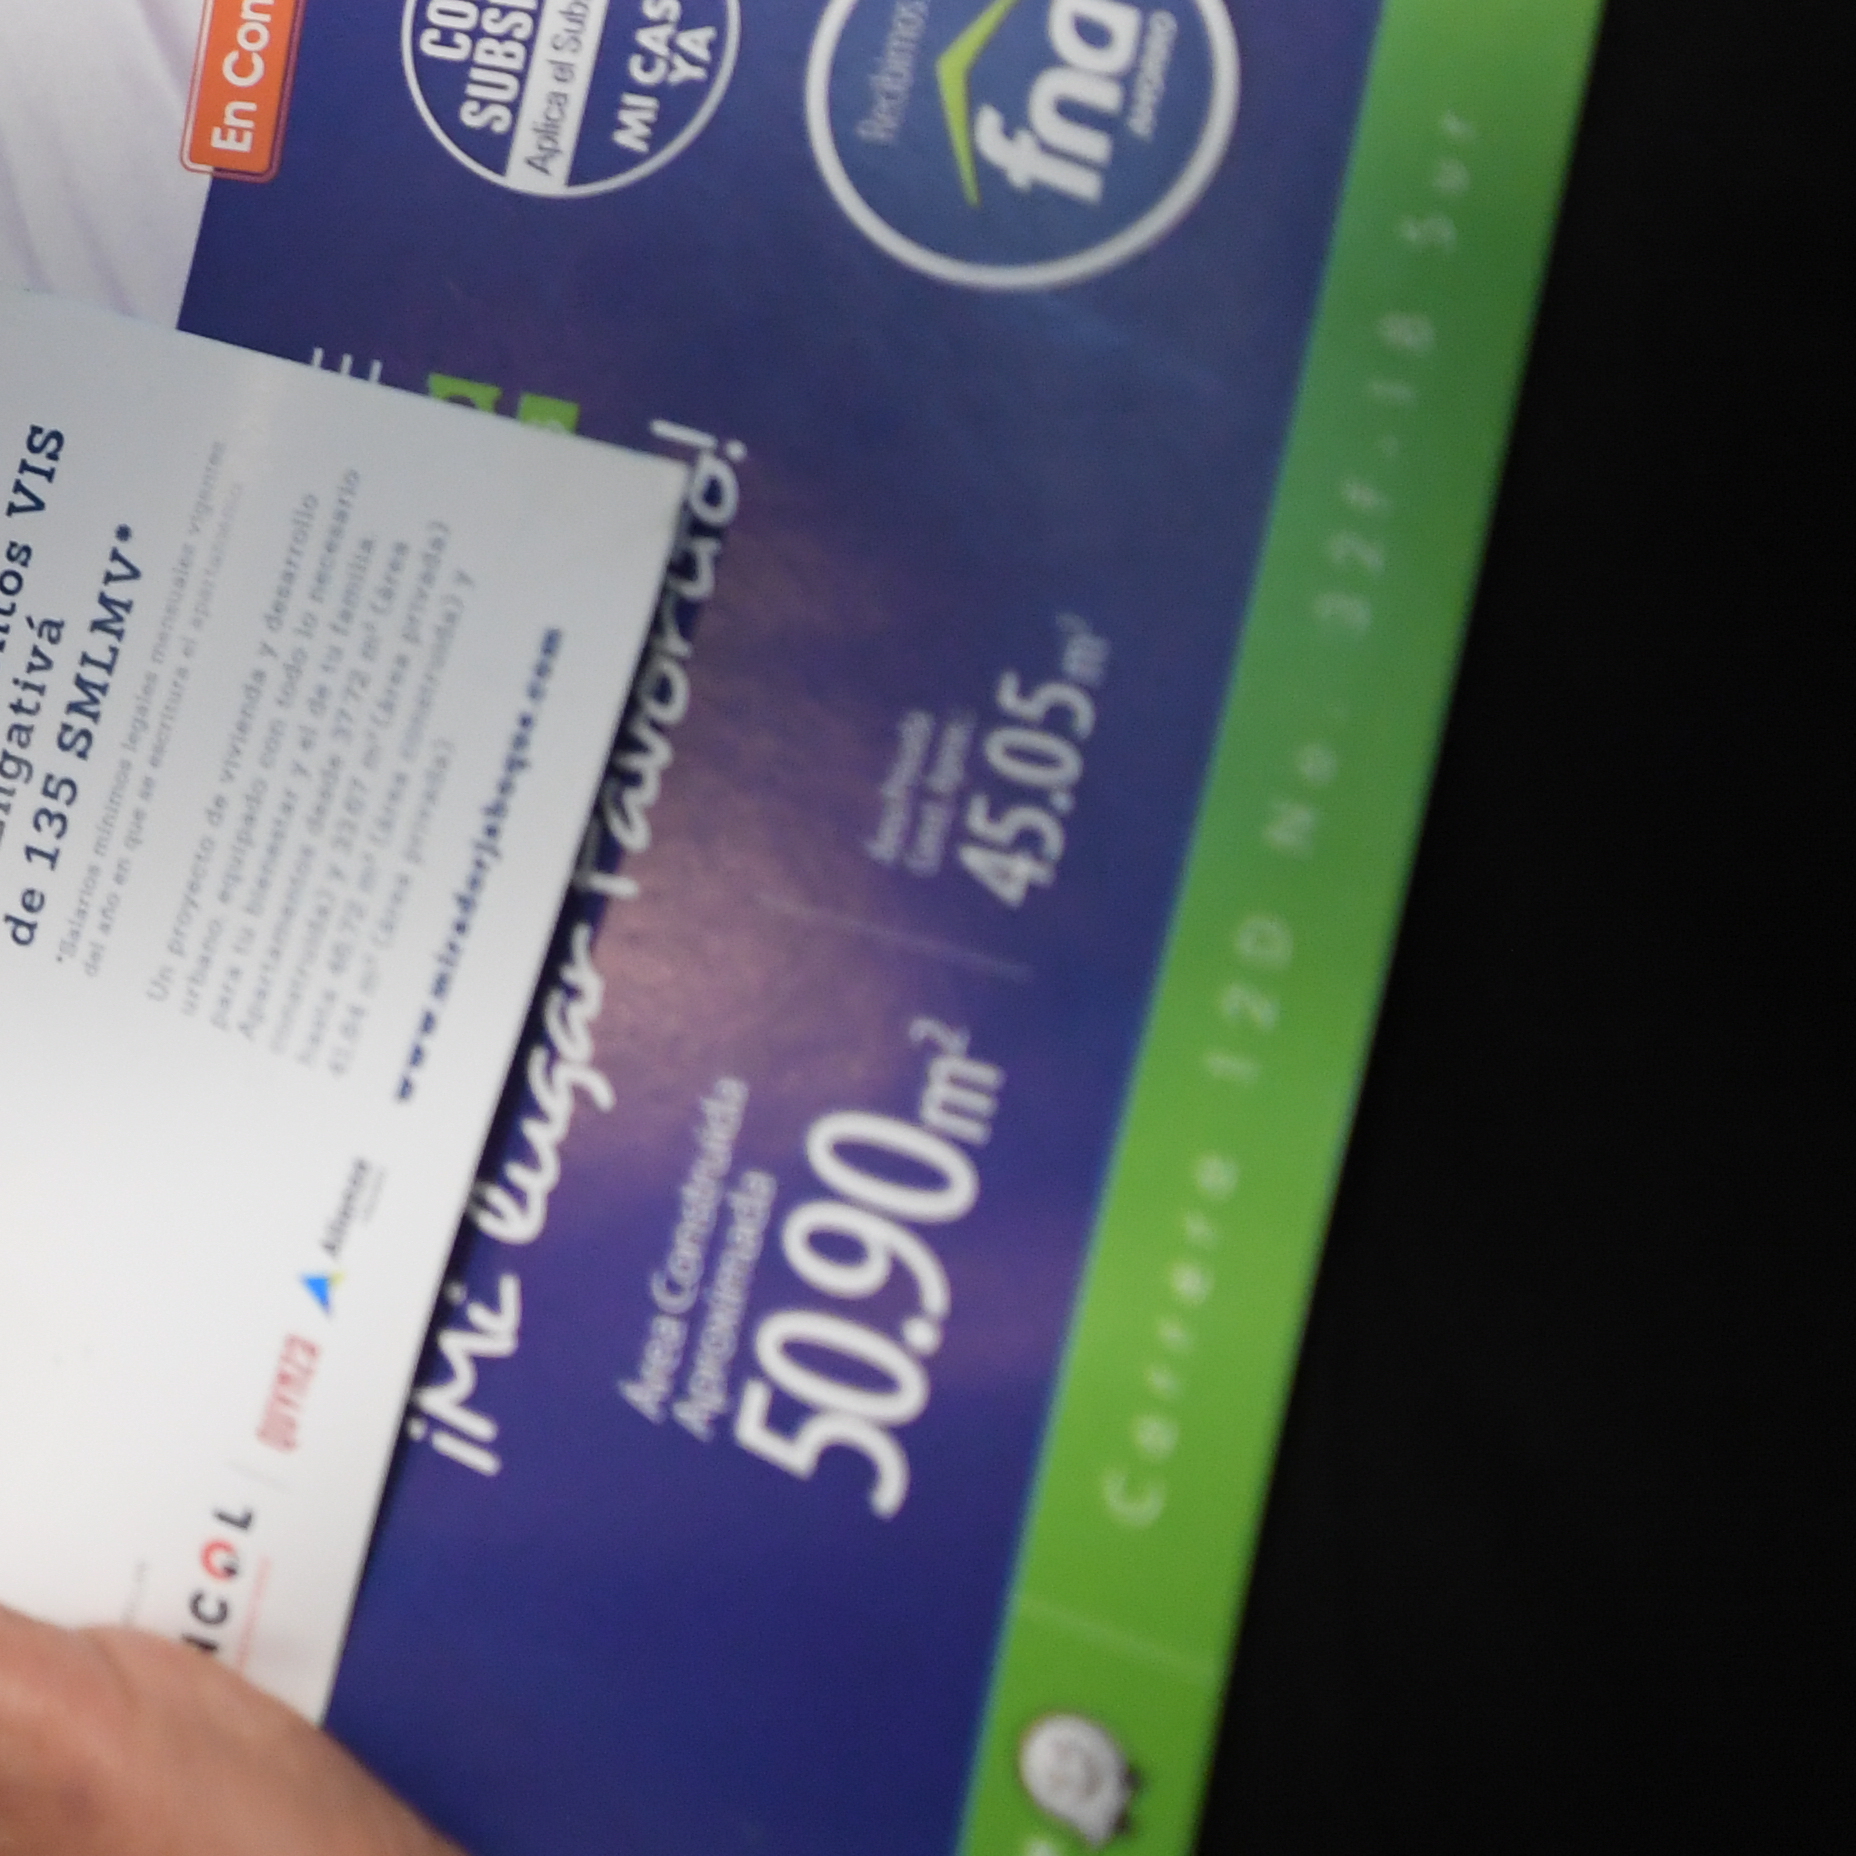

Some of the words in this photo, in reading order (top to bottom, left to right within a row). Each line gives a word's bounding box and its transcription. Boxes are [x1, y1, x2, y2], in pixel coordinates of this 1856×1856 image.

[667, 25, 717, 85] YA
[210, 100, 257, 152] En
[524, 90, 568, 176] Aplica
[546, 59, 576, 83] el
[612, 92, 660, 153] MI
[5, 424, 64, 517] VIS
[3, 888, 45, 946] de
[24, 772, 78, 869] 135
[159, 831, 218, 958] proyecto
[198, 788, 231, 829] de
[409, 1273, 521, 1475] ¡Mi
[477, 929, 614, 1242] lugar
